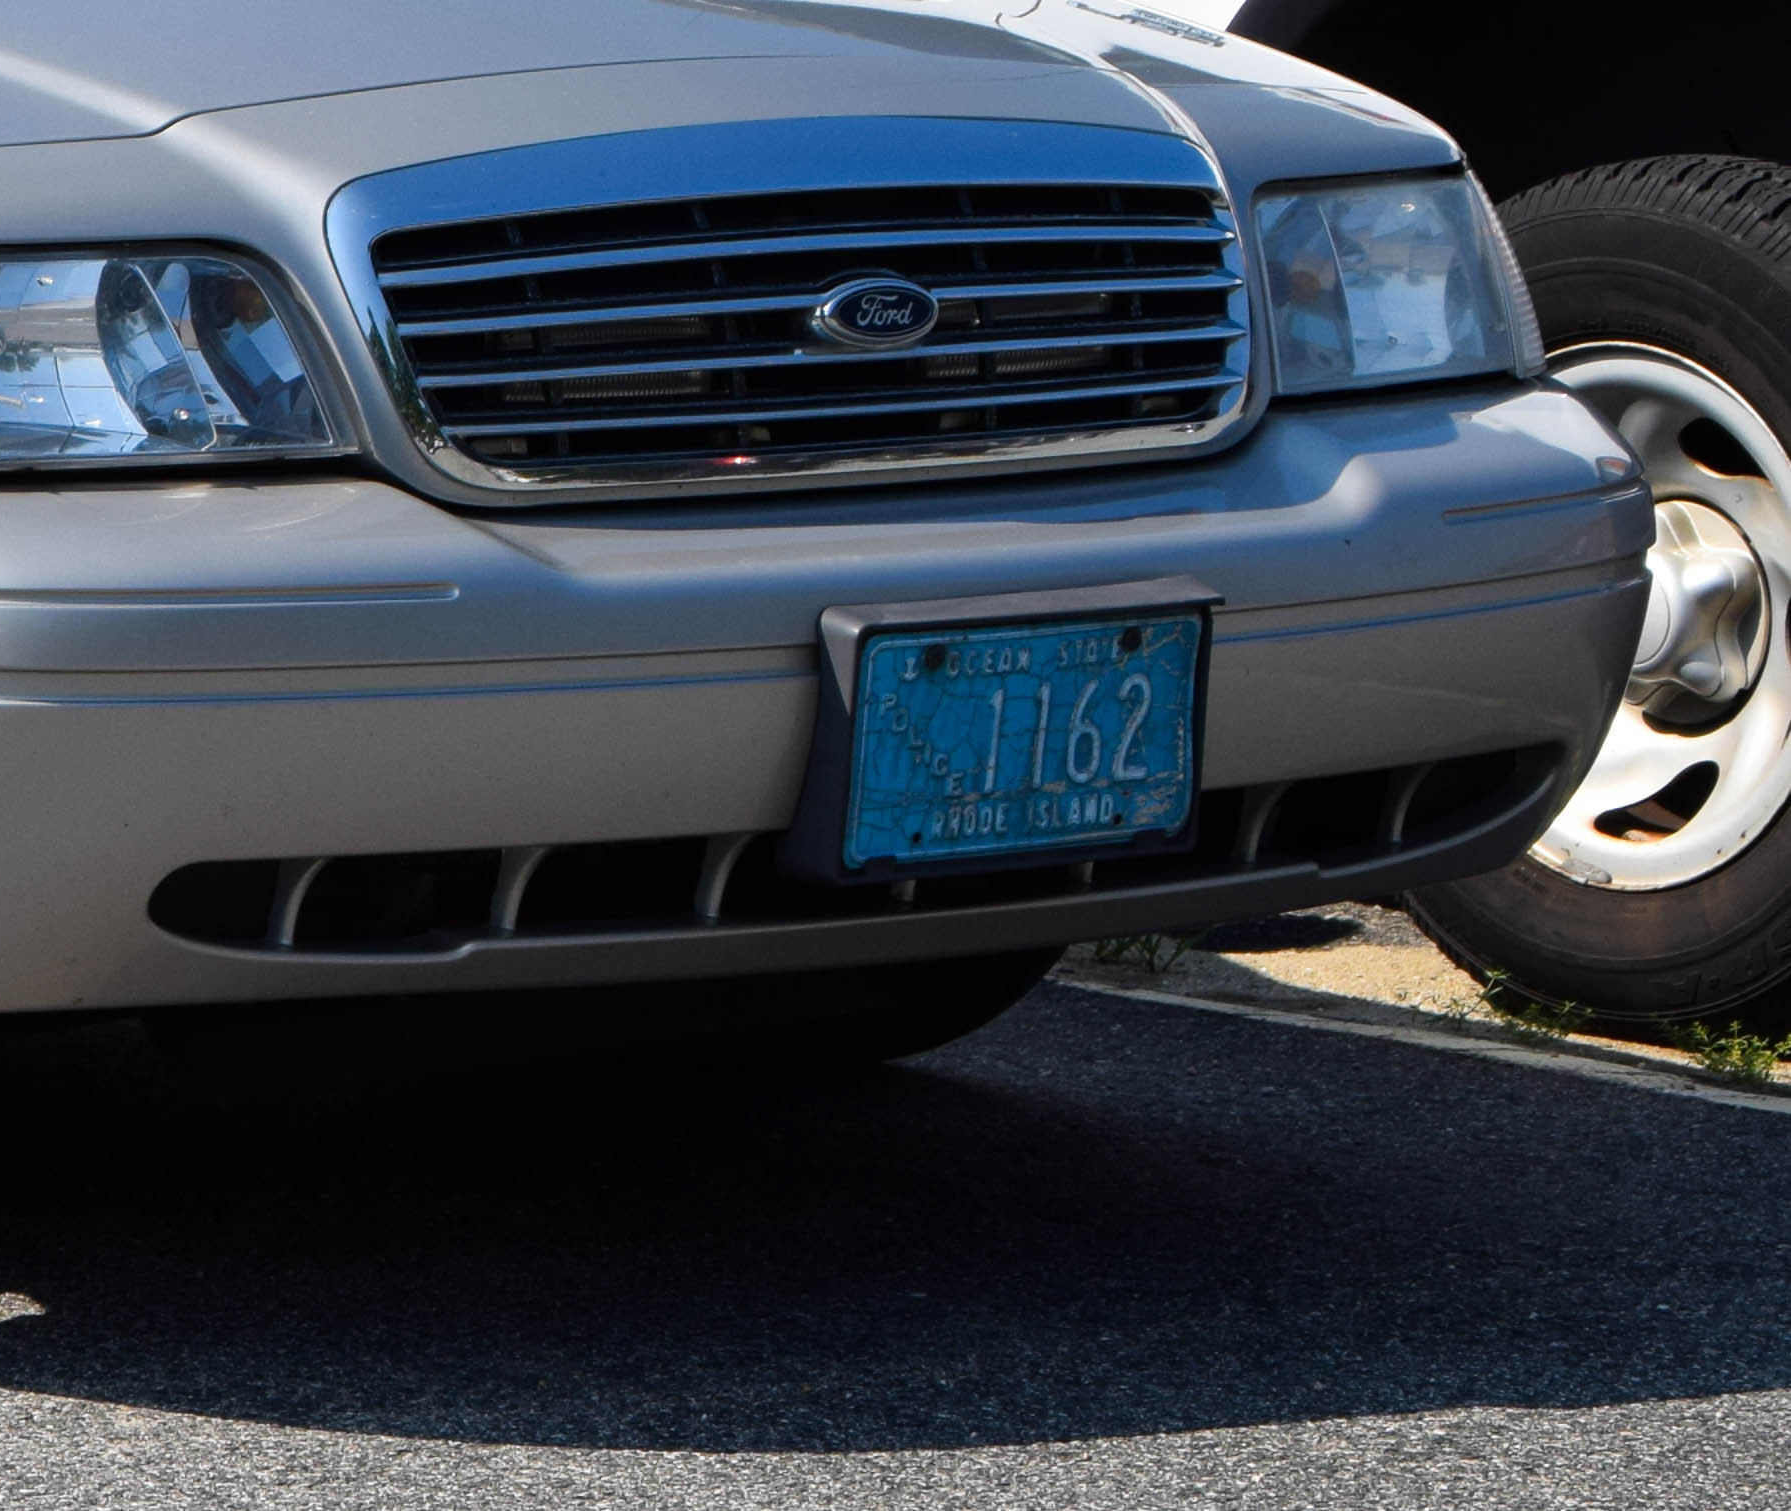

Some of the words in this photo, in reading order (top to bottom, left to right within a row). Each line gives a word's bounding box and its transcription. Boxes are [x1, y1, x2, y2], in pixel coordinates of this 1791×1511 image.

[856, 293, 914, 327] Ford
[946, 647, 1031, 678] OCEAN
[880, 692, 965, 798] POLICE
[982, 672, 1152, 794] 1162
[931, 802, 1010, 840] RHODE
[1027, 793, 1114, 829] ISLAND
